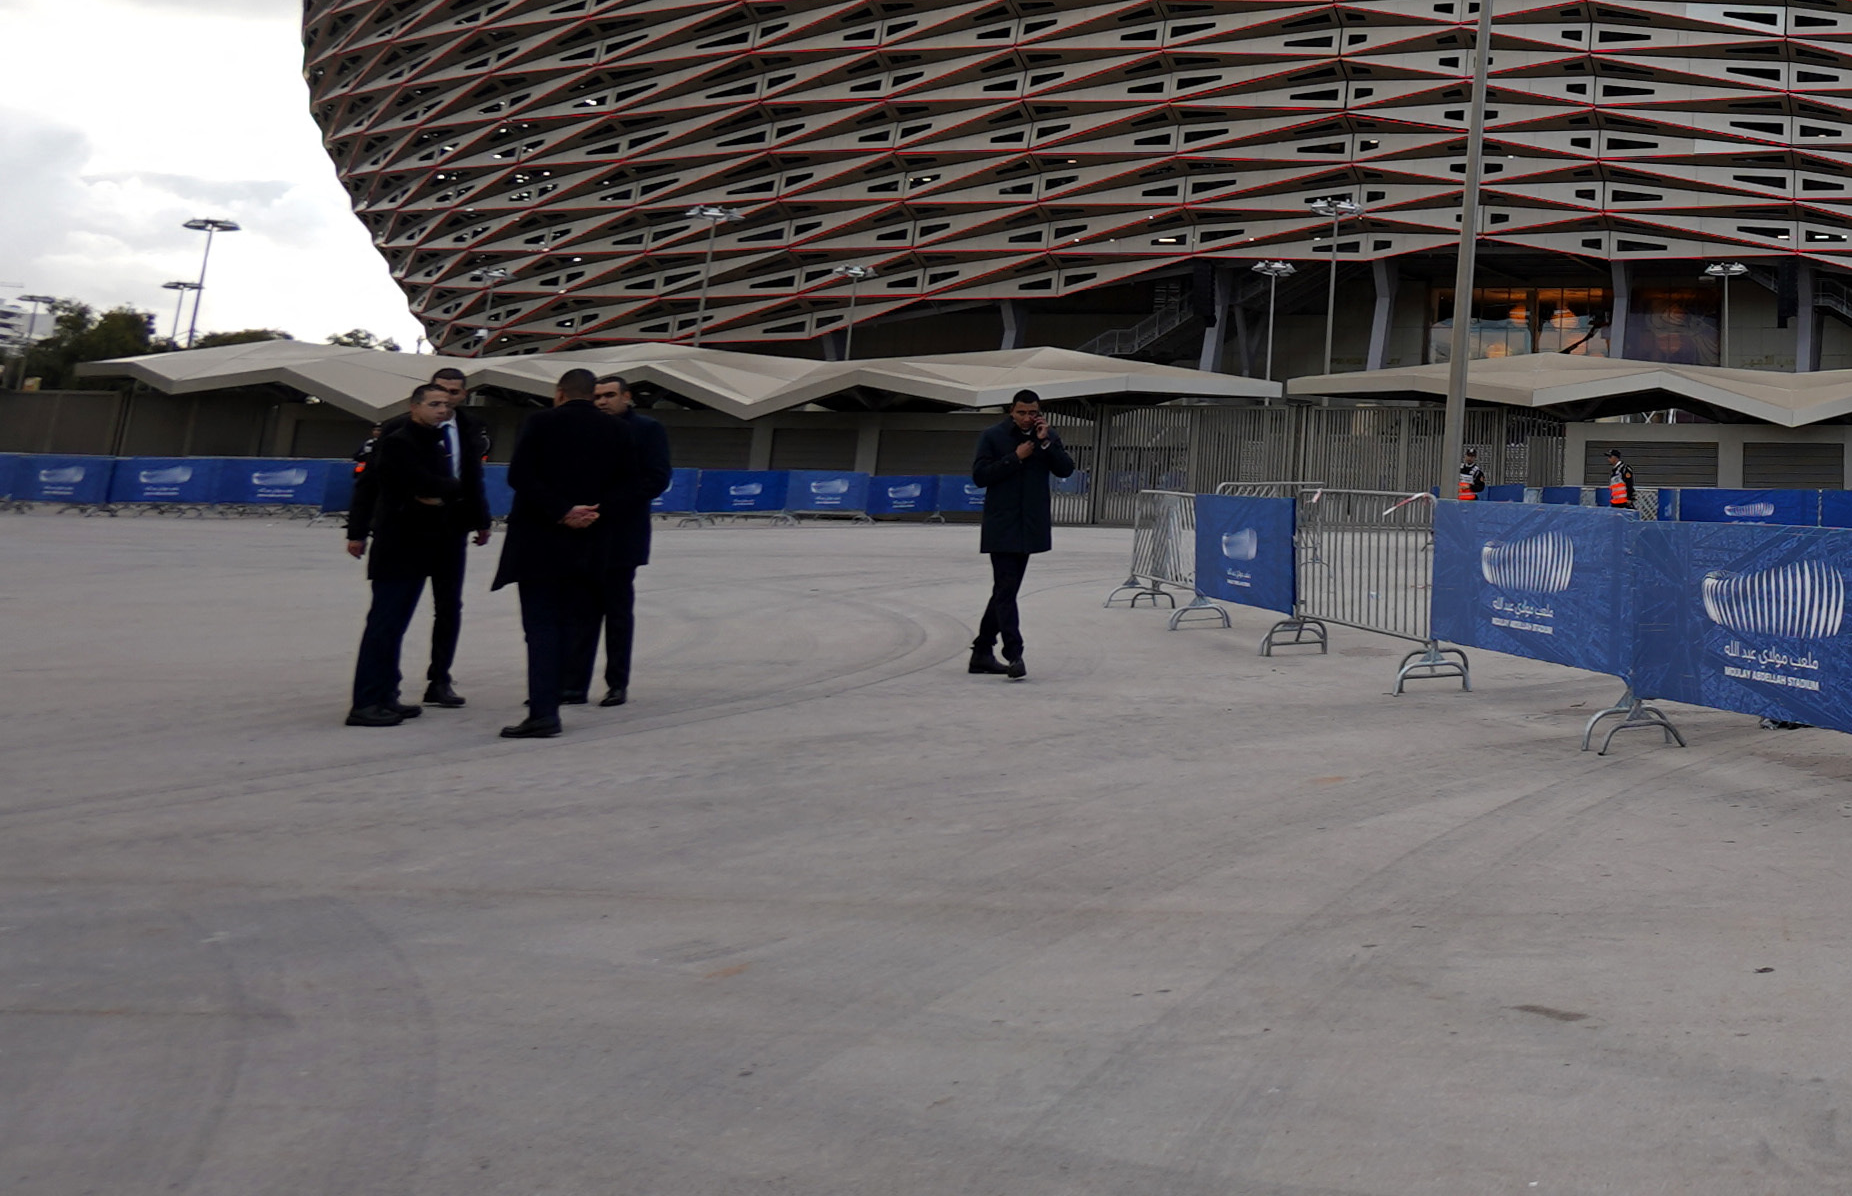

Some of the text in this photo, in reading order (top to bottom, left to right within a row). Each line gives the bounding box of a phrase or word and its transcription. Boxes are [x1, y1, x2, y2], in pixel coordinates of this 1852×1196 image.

[1724, 639, 1819, 670] ملعب مولاي عبد الله
[1724, 666, 1819, 691] MOULAY ABDELLAH STADIUM
